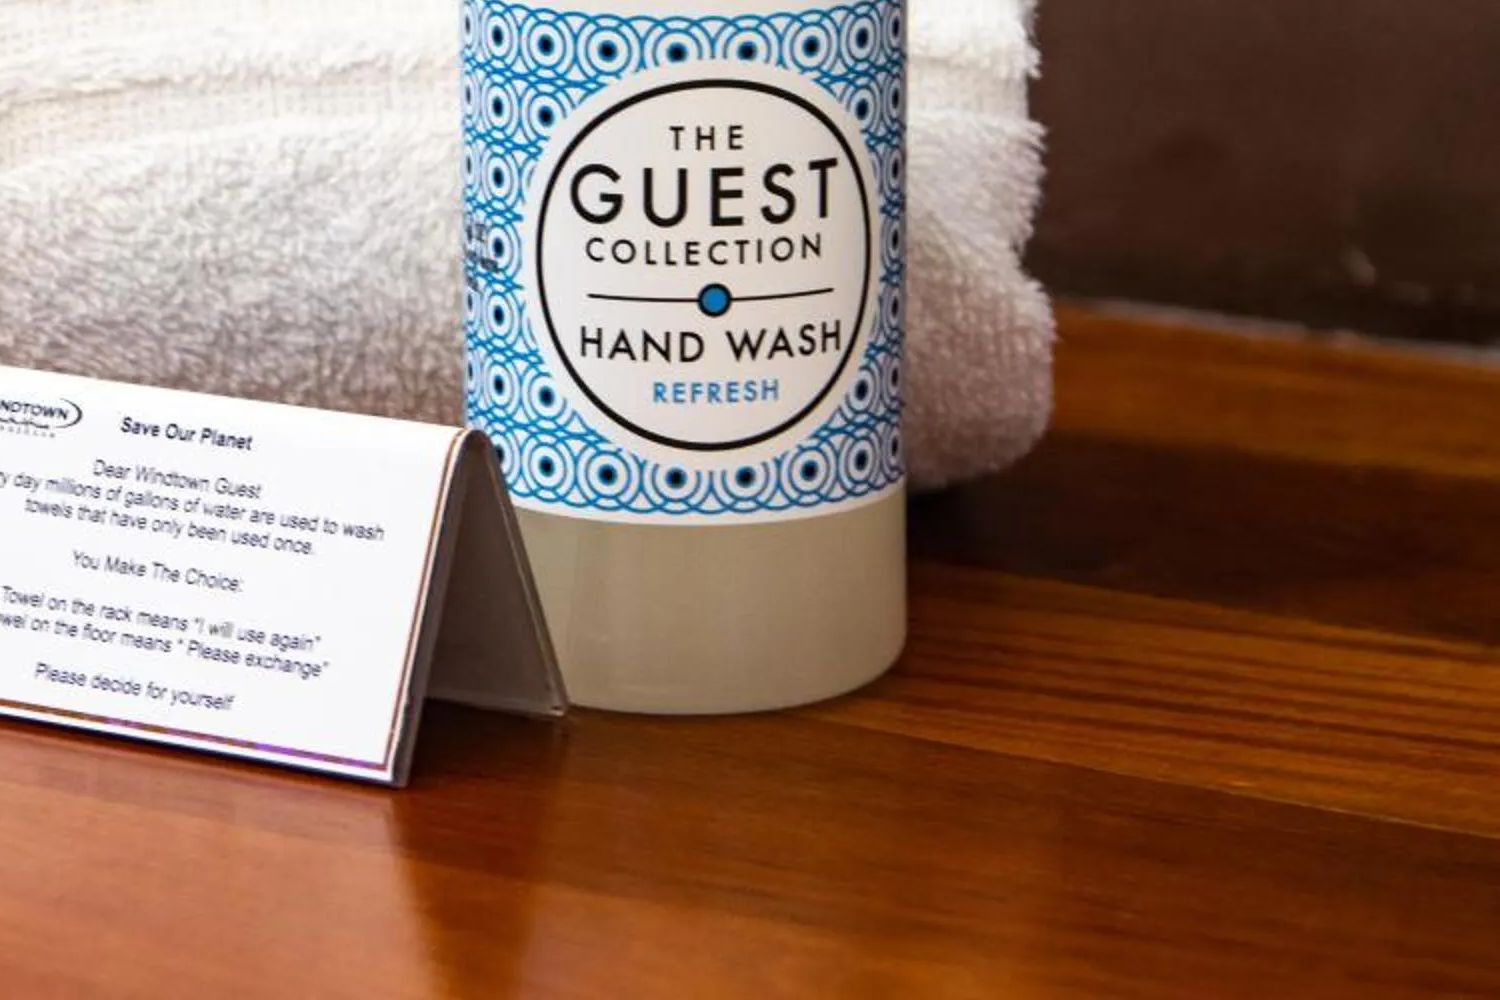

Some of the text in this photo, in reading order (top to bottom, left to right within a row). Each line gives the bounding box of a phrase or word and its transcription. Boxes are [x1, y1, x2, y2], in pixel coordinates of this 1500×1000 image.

[669, 125, 745, 151] THE
[569, 157, 838, 228] GUEST
[586, 232, 822, 266] COLLECTION
[580, 319, 842, 363] HAND WASH
[653, 378, 780, 403] REFRESH
[120, 416, 253, 450] Save Our Planet
[93, 459, 262, 499] Dear Windtown Guest
[13, 473, 41, 493] day
[45, 477, 101, 499] millions
[106, 486, 122, 501] of
[124, 490, 179, 511] gallons
[184, 498, 201, 512] of
[203, 502, 246, 520] water
[249, 509, 275, 525] are
[279, 514, 319, 532] used
[323, 517, 338, 534] to
[343, 522, 385, 541] wash
[25, 498, 73, 519] towels
[77, 504, 107, 524] that
[109, 510, 147, 529] have
[151, 518, 184, 538] only
[187, 520, 227, 542] been
[231, 529, 270, 548] used
[72, 549, 100, 570] You
[104, 555, 147, 577] Make
[152, 561, 181, 582] The
[1, 585, 45, 608] Towel
[48, 597, 67, 611] on
[71, 599, 95, 616] the
[101, 604, 132, 621] rack
[136, 611, 188, 632] means
[209, 621, 234, 638] will
[237, 629, 266, 644] use
[31, 618, 50, 631] on
[54, 620, 78, 637] the
[83, 623, 117, 643] floor
[121, 632, 173, 653] means
[187, 639, 241, 664] Please
[34, 661, 235, 710] Please decide for yourself
